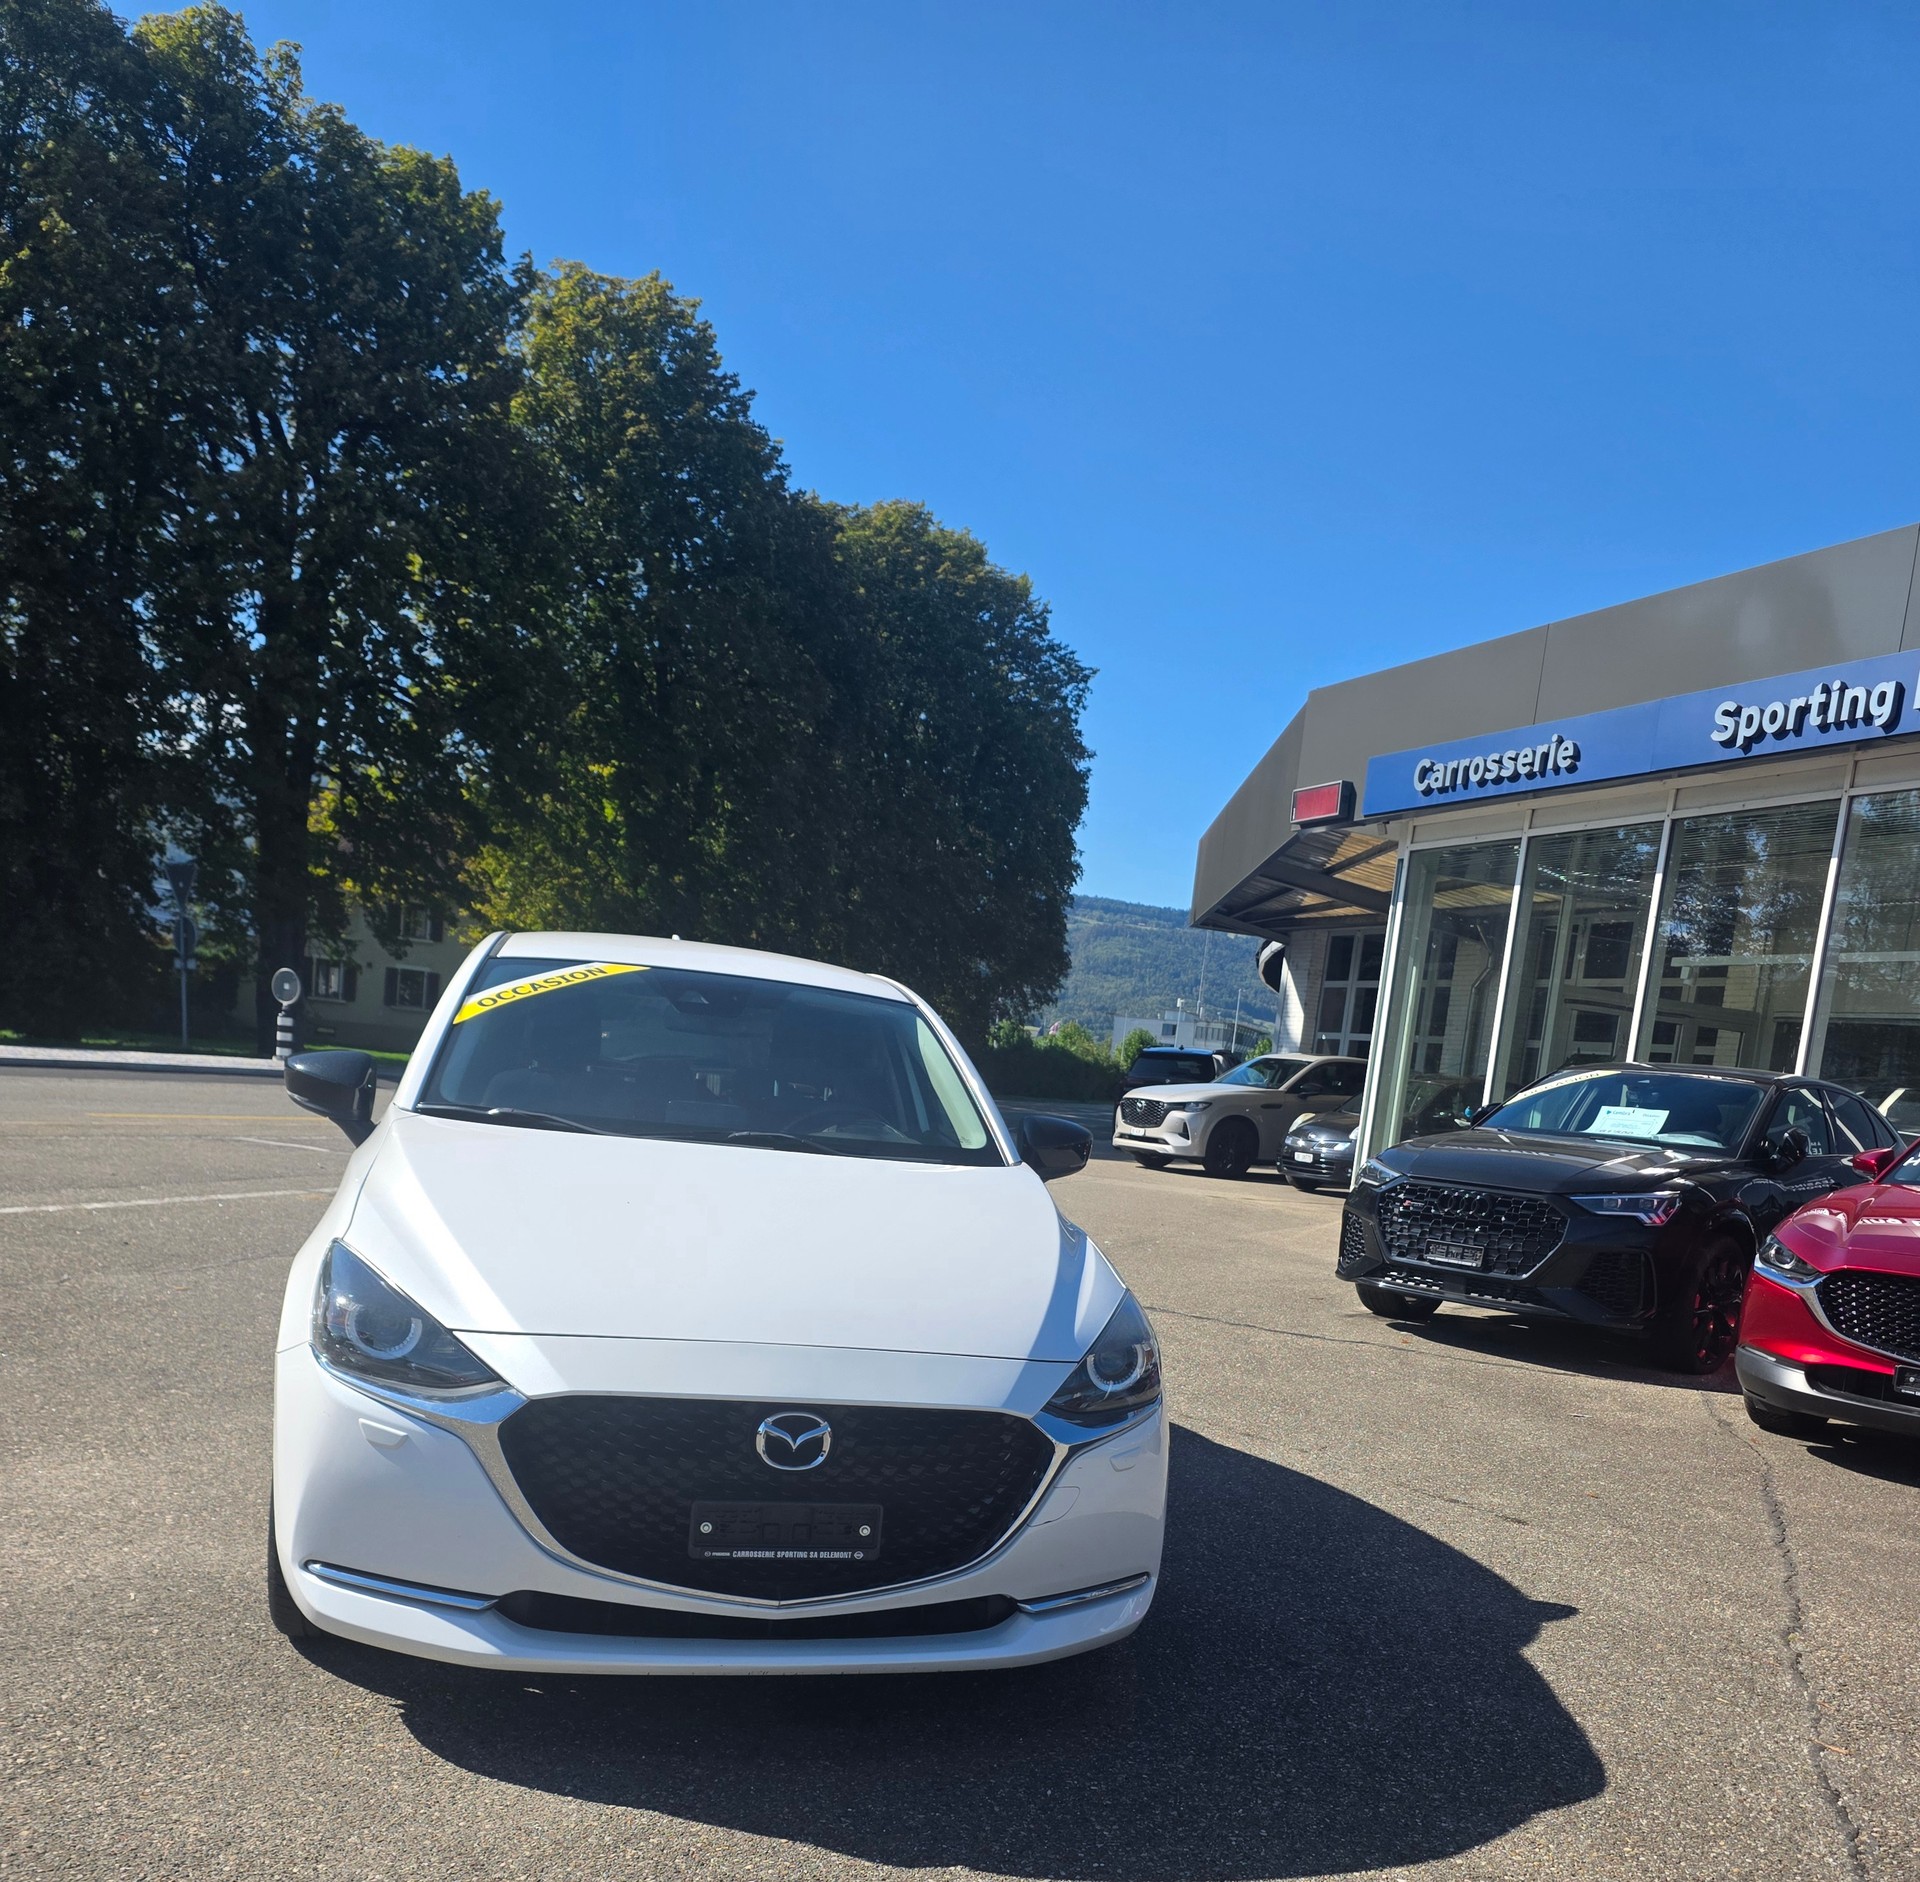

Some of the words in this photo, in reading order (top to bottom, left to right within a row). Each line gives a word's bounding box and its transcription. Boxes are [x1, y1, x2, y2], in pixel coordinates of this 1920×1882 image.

[1414, 734, 1576, 792] Carrosserie
[1711, 679, 1898, 746] Sporting
[477, 967, 607, 1007] OCCASION
[732, 1550, 775, 1558] CARROSSERIE
[776, 1551, 808, 1559] SPORTING
[809, 1551, 818, 1559] SA
[819, 1551, 852, 1559] DELEMONT
